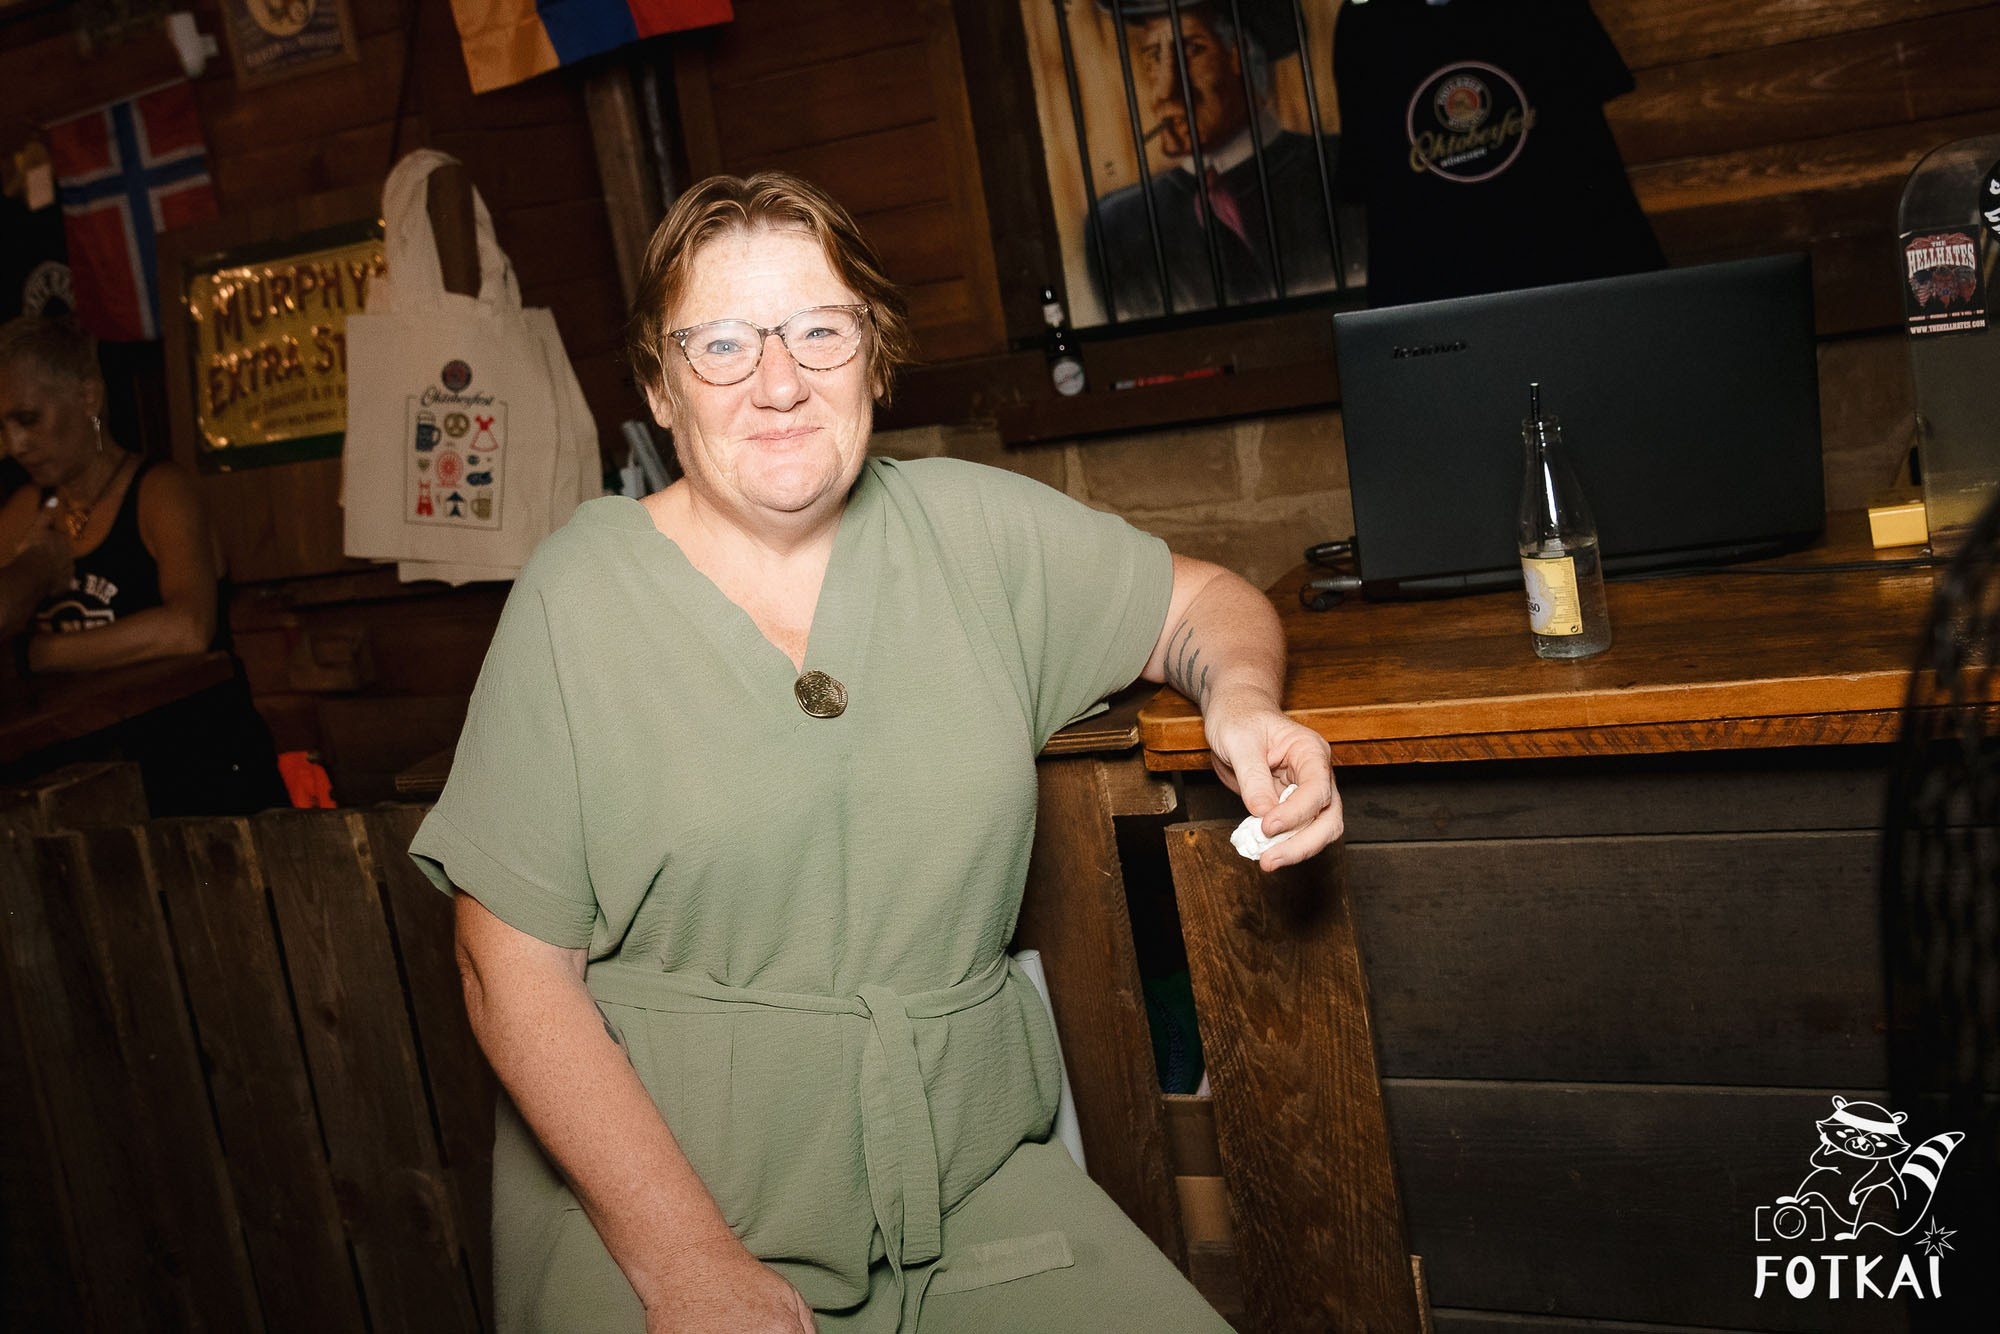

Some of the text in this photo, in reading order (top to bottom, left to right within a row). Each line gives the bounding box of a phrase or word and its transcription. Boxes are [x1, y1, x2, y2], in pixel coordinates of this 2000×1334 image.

[1905, 243, 1976, 279] HELLHATES
[208, 340, 304, 417] EXTRA
[420, 384, 495, 409] Oktoberfest
